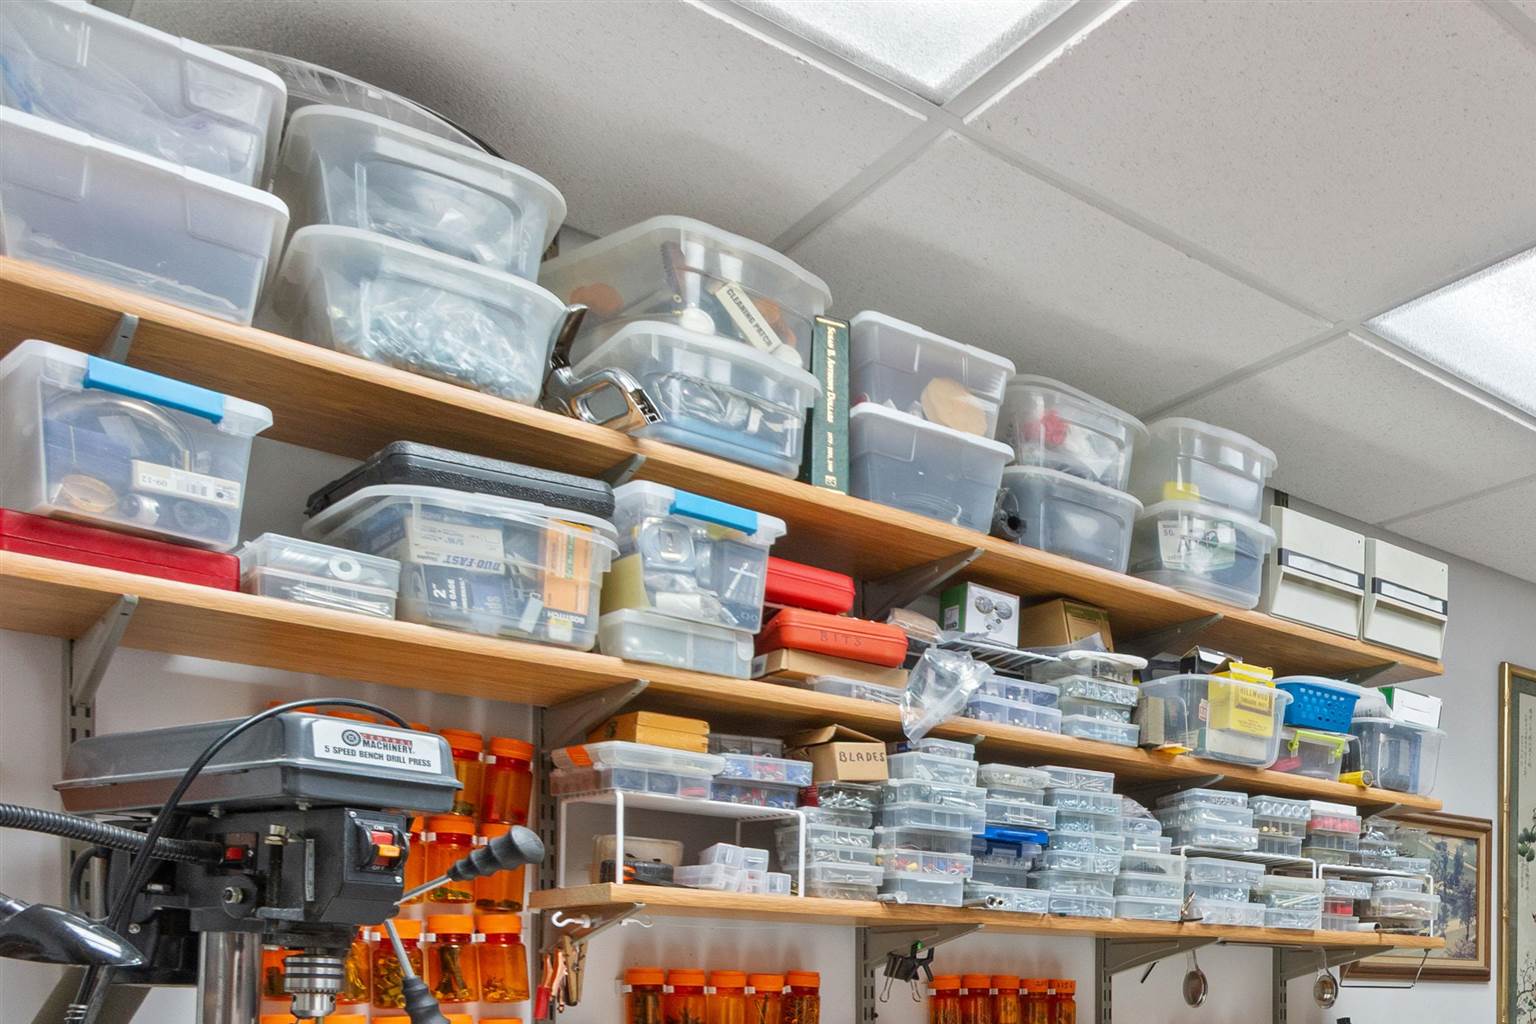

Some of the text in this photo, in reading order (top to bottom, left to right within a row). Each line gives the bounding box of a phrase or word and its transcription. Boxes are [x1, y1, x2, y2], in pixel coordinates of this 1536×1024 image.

[726, 287, 773, 348] CLEANING PATCH
[826, 358, 836, 390] ANTHONY
[826, 391, 837, 423] DOLLARS
[819, 629, 863, 647] BITS
[324, 744, 432, 768] 5 SPEED BENCH DRILL PRESS
[362, 739, 414, 754] MACHINERY
[838, 751, 886, 763] BLADES
